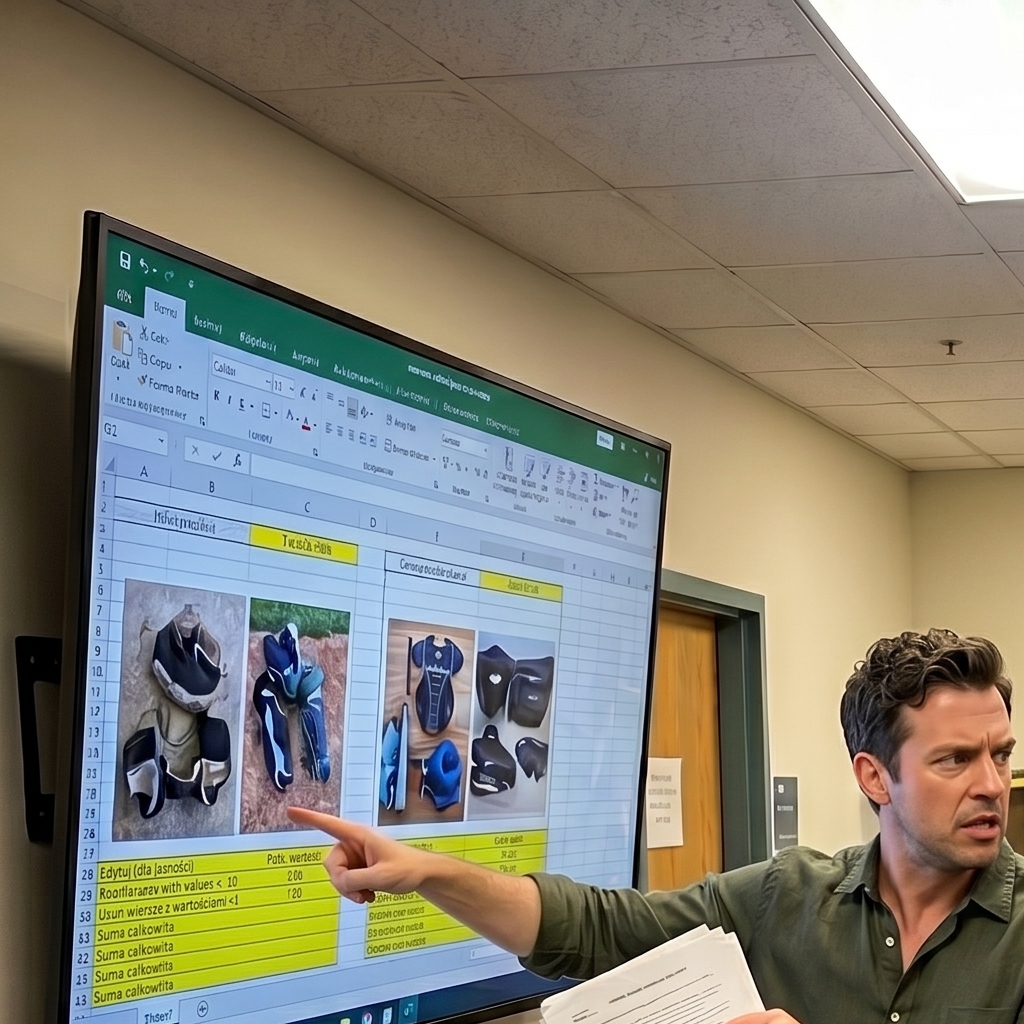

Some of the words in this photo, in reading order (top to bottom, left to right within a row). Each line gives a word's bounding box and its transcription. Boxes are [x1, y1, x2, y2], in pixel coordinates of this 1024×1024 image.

[104, 422, 118, 438] G2
[140, 465, 149, 478] A
[209, 481, 215, 493] B
[304, 501, 311, 513] C
[370, 517, 377, 528] D
[101, 502, 107, 513] 2
[97, 584, 104, 596] 6
[96, 604, 103, 616] 7
[95, 625, 101, 637] 8
[94, 645, 101, 657] 9
[81, 869, 94, 881] 28
[100, 864, 132, 881] Edytuj
[161, 880, 182, 894] with
[184, 878, 214, 892] values
[227, 876, 238, 888] 10
[80, 890, 93, 902] 29
[127, 904, 164, 918] wiersze
[97, 929, 125, 942] Suma
[96, 949, 125, 963] Suma
[95, 970, 124, 983] Suma
[94, 990, 122, 1004] Suma
